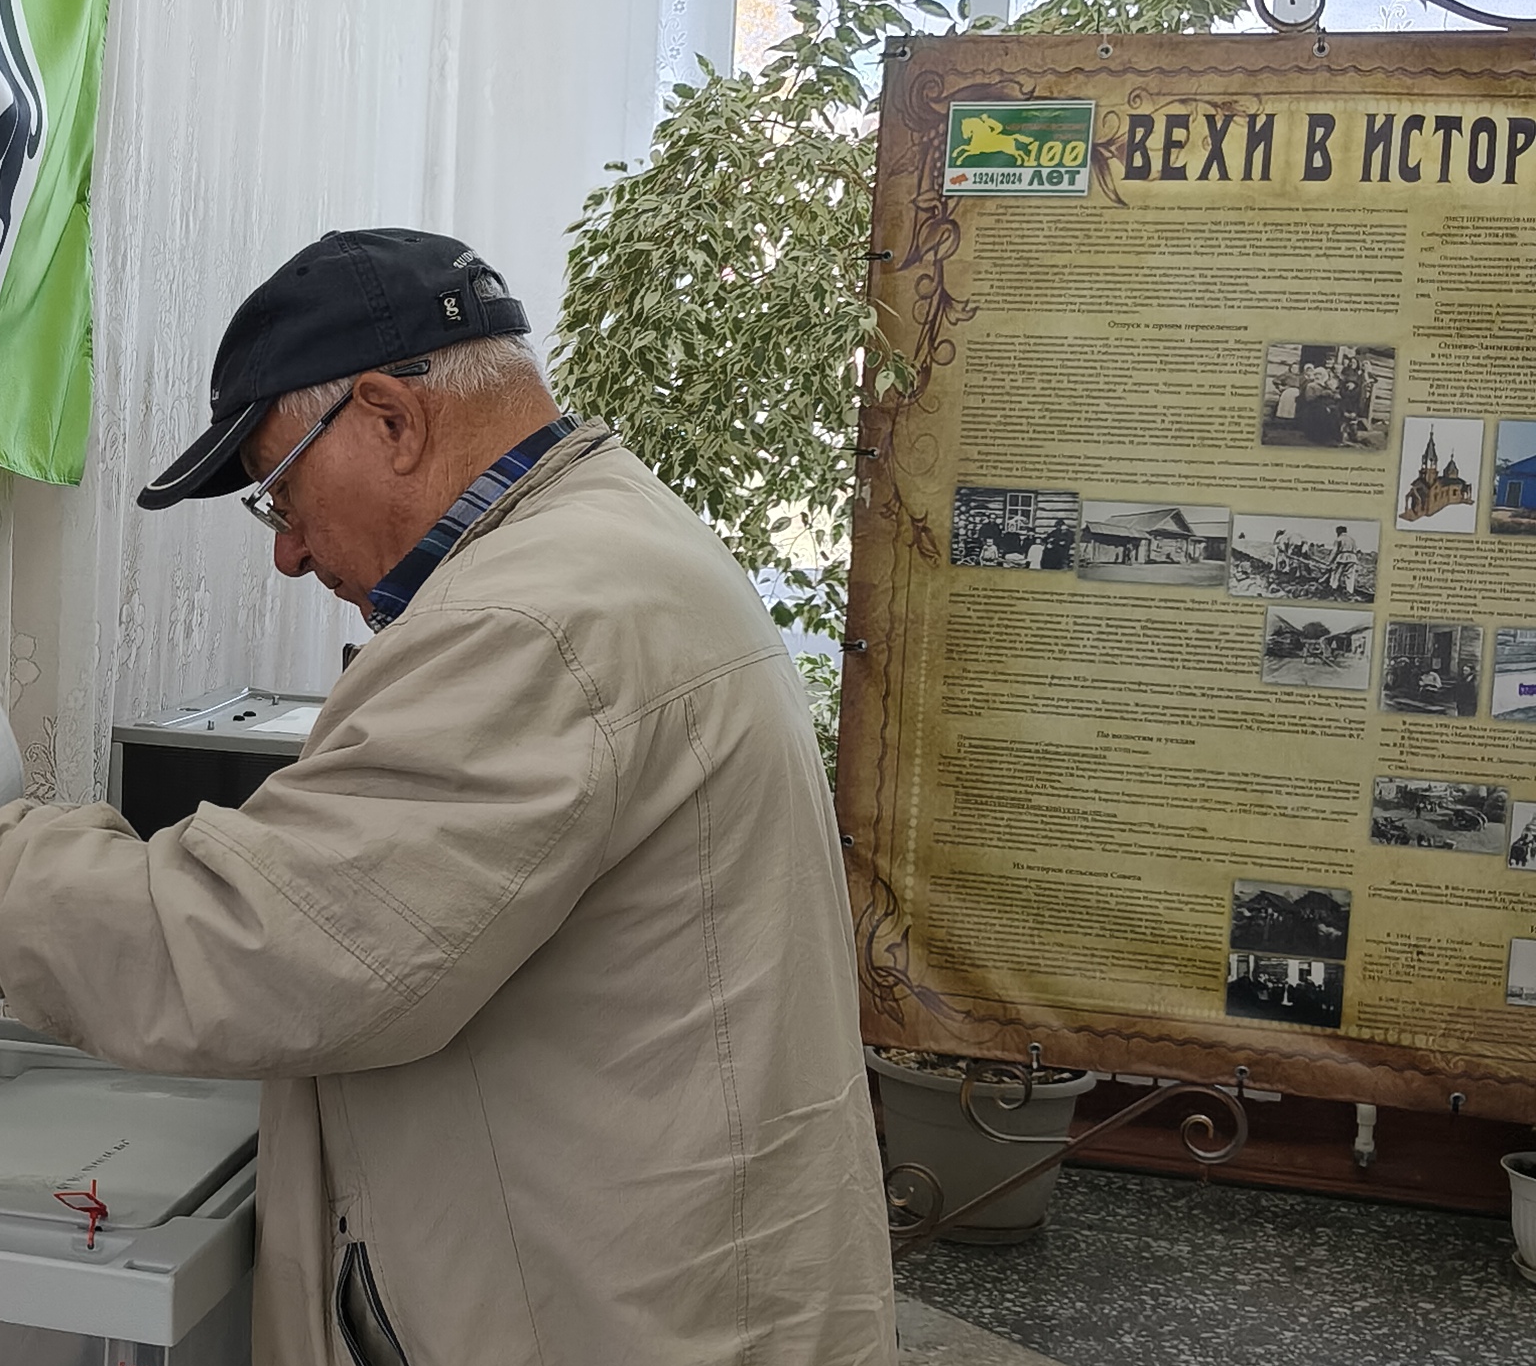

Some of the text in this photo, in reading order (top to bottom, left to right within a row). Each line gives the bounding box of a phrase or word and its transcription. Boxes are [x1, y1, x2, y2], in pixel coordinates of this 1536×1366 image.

[1023, 140, 1086, 167] 100
[1121, 113, 1536, 185] ВЕХИ В ИСТОР
